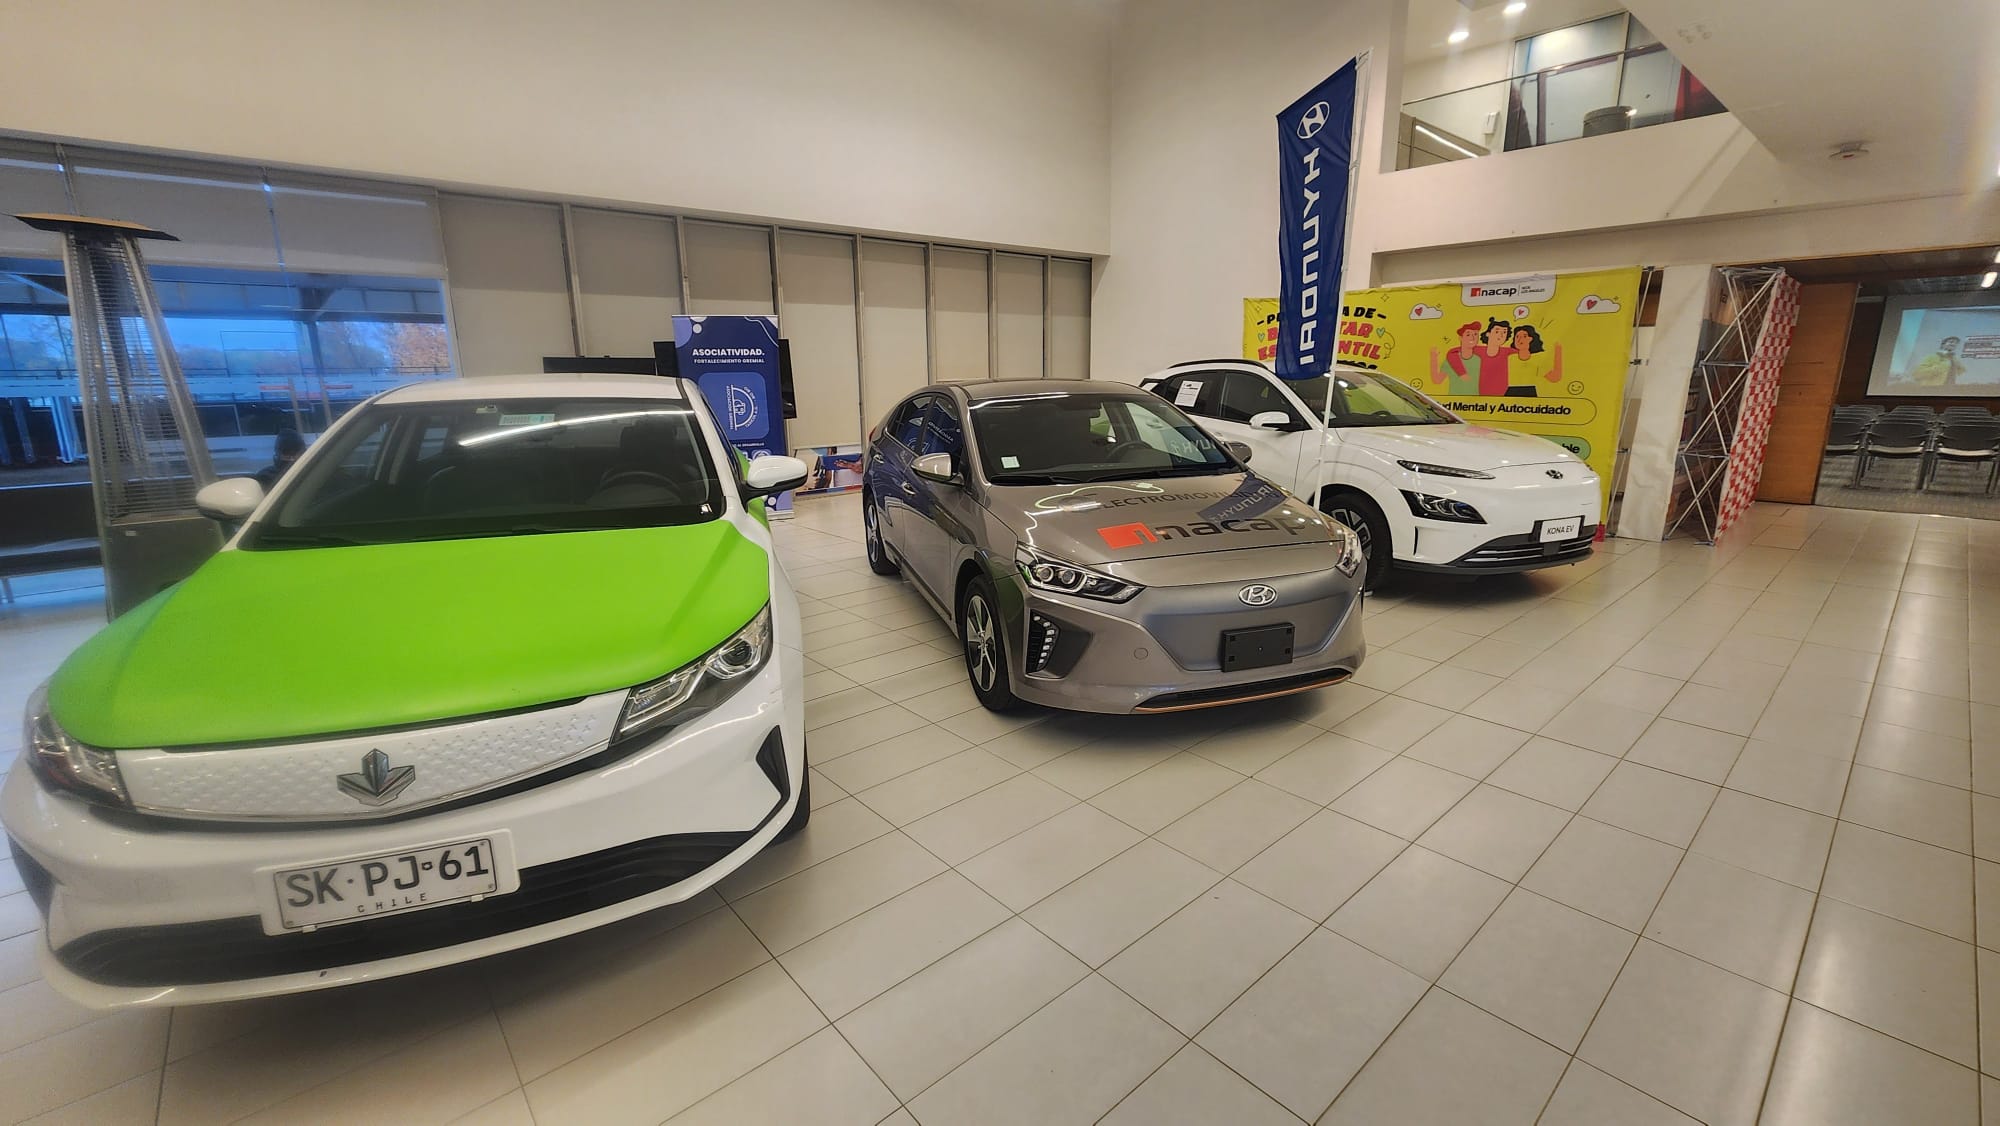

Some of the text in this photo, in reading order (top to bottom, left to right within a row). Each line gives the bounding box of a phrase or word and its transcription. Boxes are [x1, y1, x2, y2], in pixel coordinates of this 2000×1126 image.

[1353, 306, 1376, 319] DE
[692, 348, 765, 356] ASOCIATIVIDAD.
[1453, 402, 1487, 412] Mental
[1490, 404, 1496, 414] y
[1497, 403, 1572, 415] Autocuidado
[1547, 524, 1575, 535] KONA EV
[357, 892, 428, 914] CHILE
